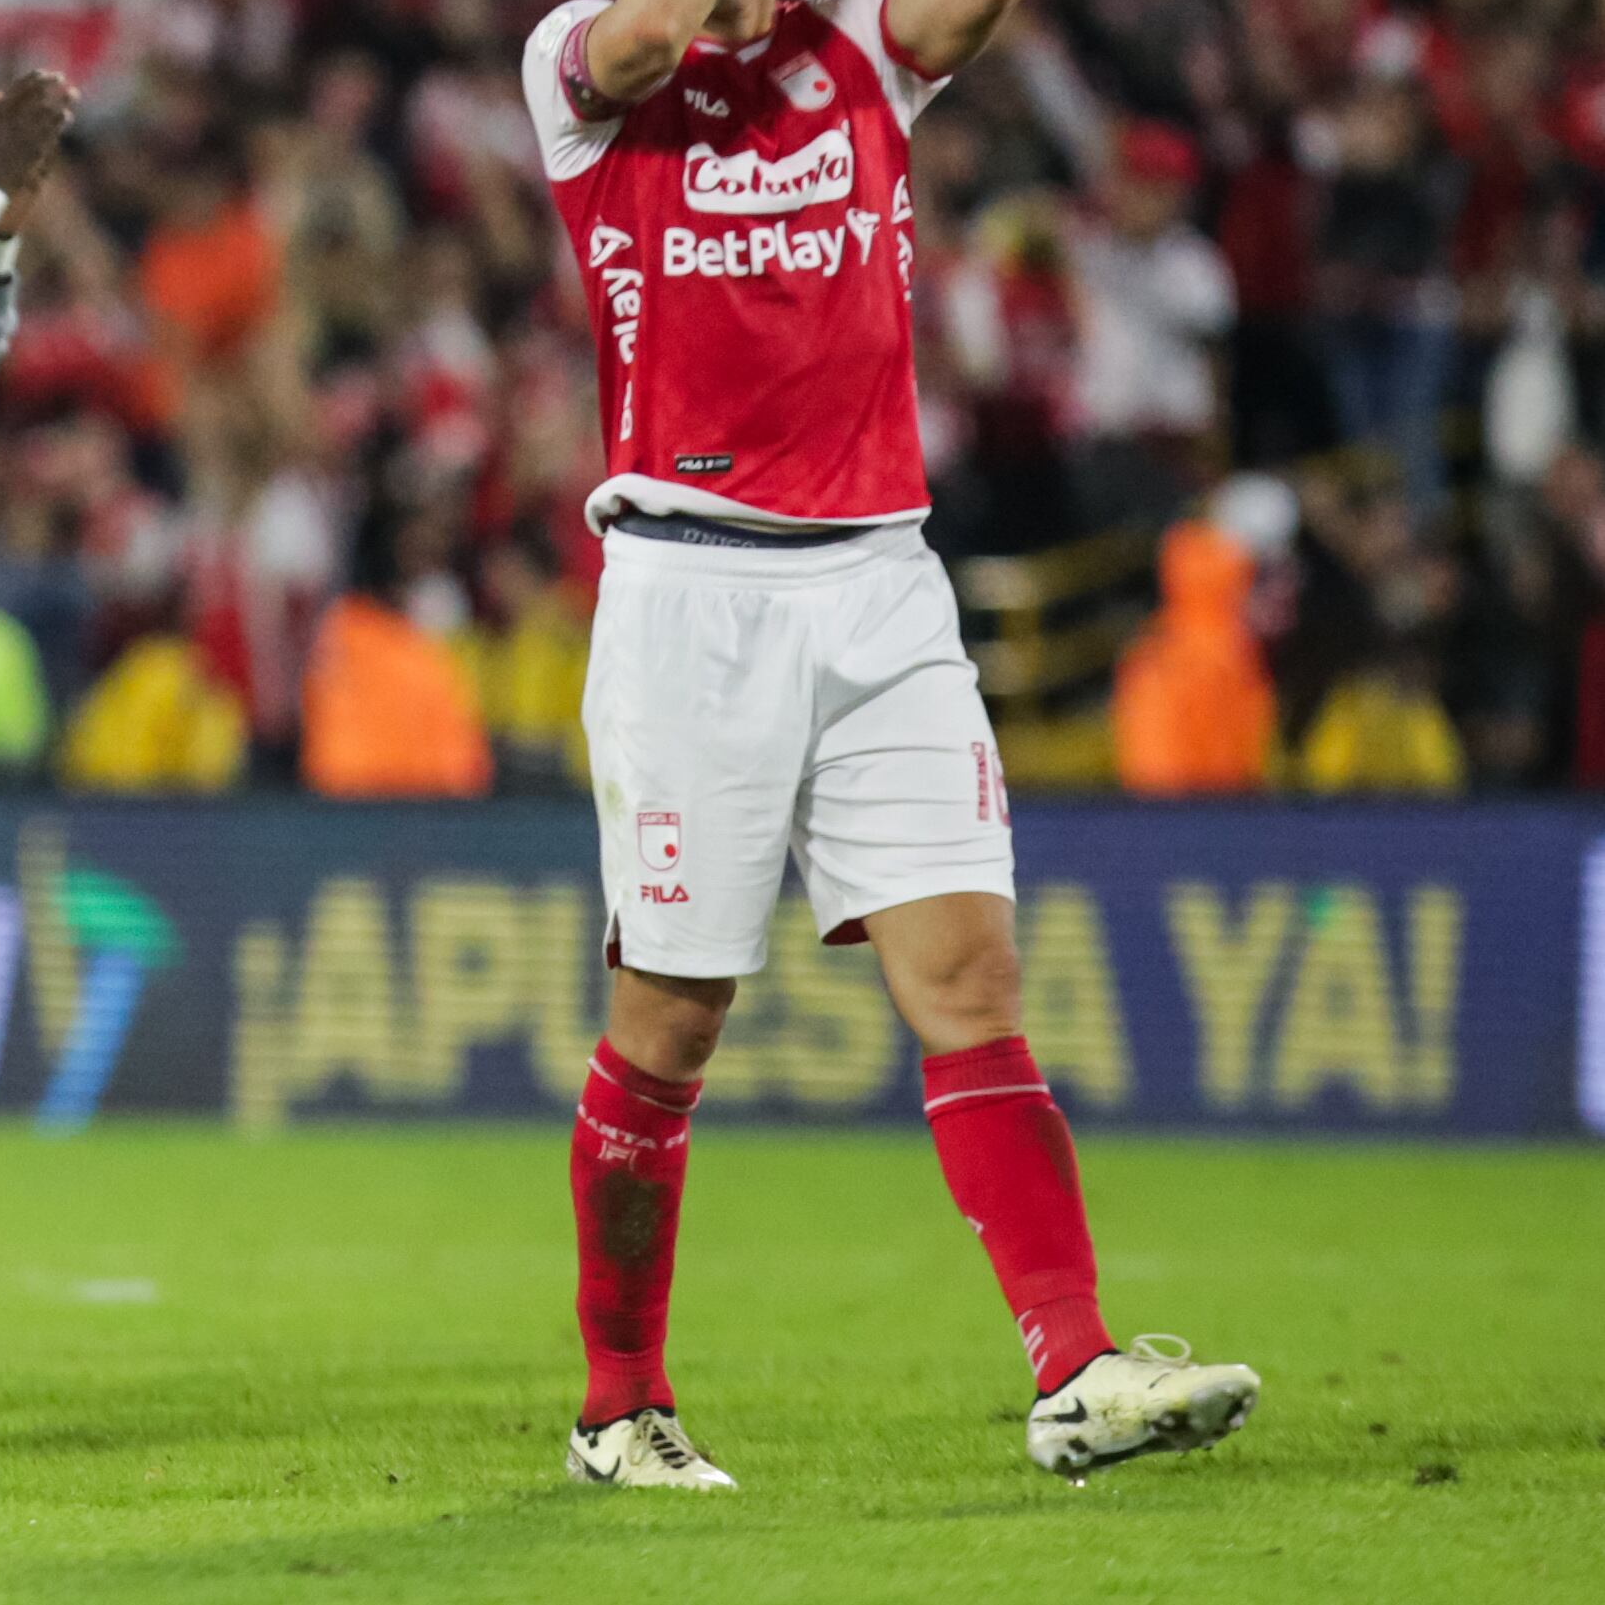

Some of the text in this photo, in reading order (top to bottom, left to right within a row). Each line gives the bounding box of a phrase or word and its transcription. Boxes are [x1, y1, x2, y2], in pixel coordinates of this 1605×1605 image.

[663, 220, 846, 278] BetPlay
[639, 883, 690, 904] FILA
[1161, 878, 1466, 1111] YA!
